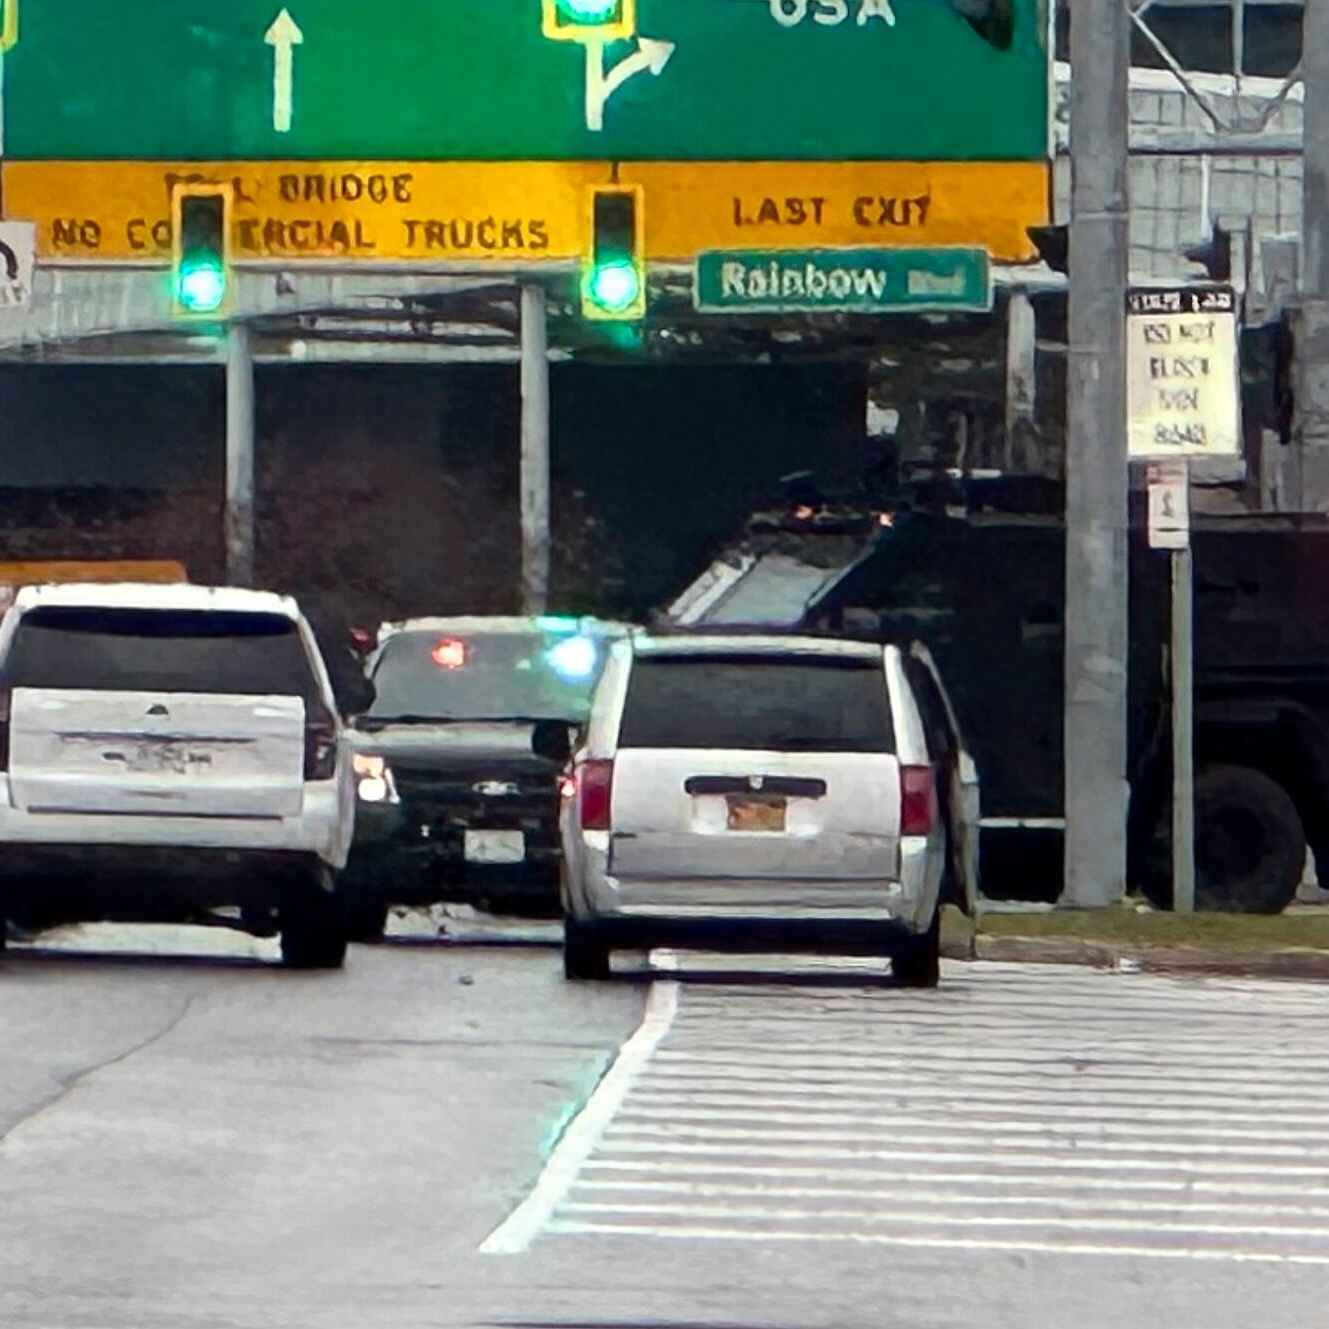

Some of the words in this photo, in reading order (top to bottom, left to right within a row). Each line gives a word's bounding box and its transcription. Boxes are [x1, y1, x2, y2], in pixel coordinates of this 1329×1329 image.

[279, 173, 413, 204] BRIDGE
[733, 196, 826, 228] LAST
[52, 218, 101, 249] NO
[127, 218, 376, 252] COERCIAL
[402, 218, 549, 250] TRUCKS
[721, 262, 887, 300] Rainbow
